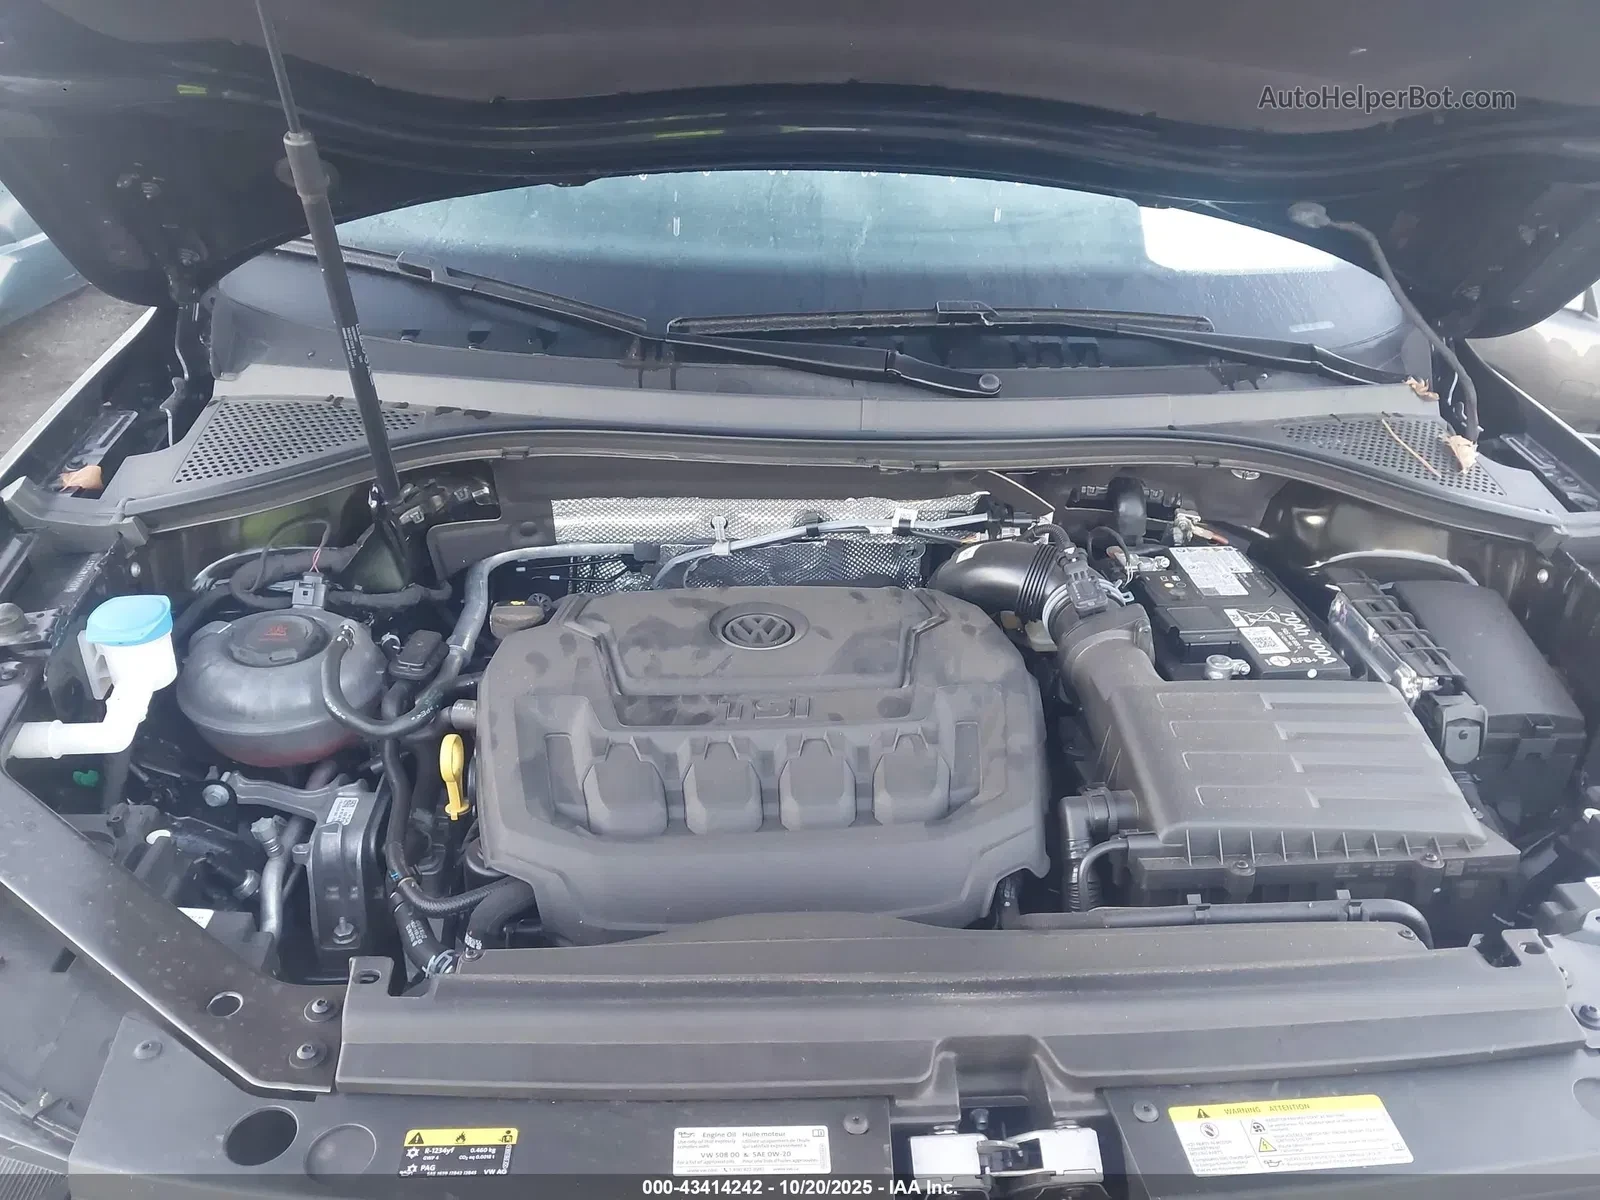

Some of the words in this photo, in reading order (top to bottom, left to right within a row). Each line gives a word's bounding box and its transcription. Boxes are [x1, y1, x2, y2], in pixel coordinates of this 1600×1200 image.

[1280, 611, 1311, 636] 70Ah
[1303, 638, 1338, 665] 700A
[716, 696, 811, 721] TSI
[1224, 1106, 1262, 1116] WARNING
[1269, 1103, 1311, 1113] ATTENTION
[424, 1147, 456, 1156] R-1234yf
[488, 1147, 497, 1155] kg
[420, 1164, 436, 1172] PAG
